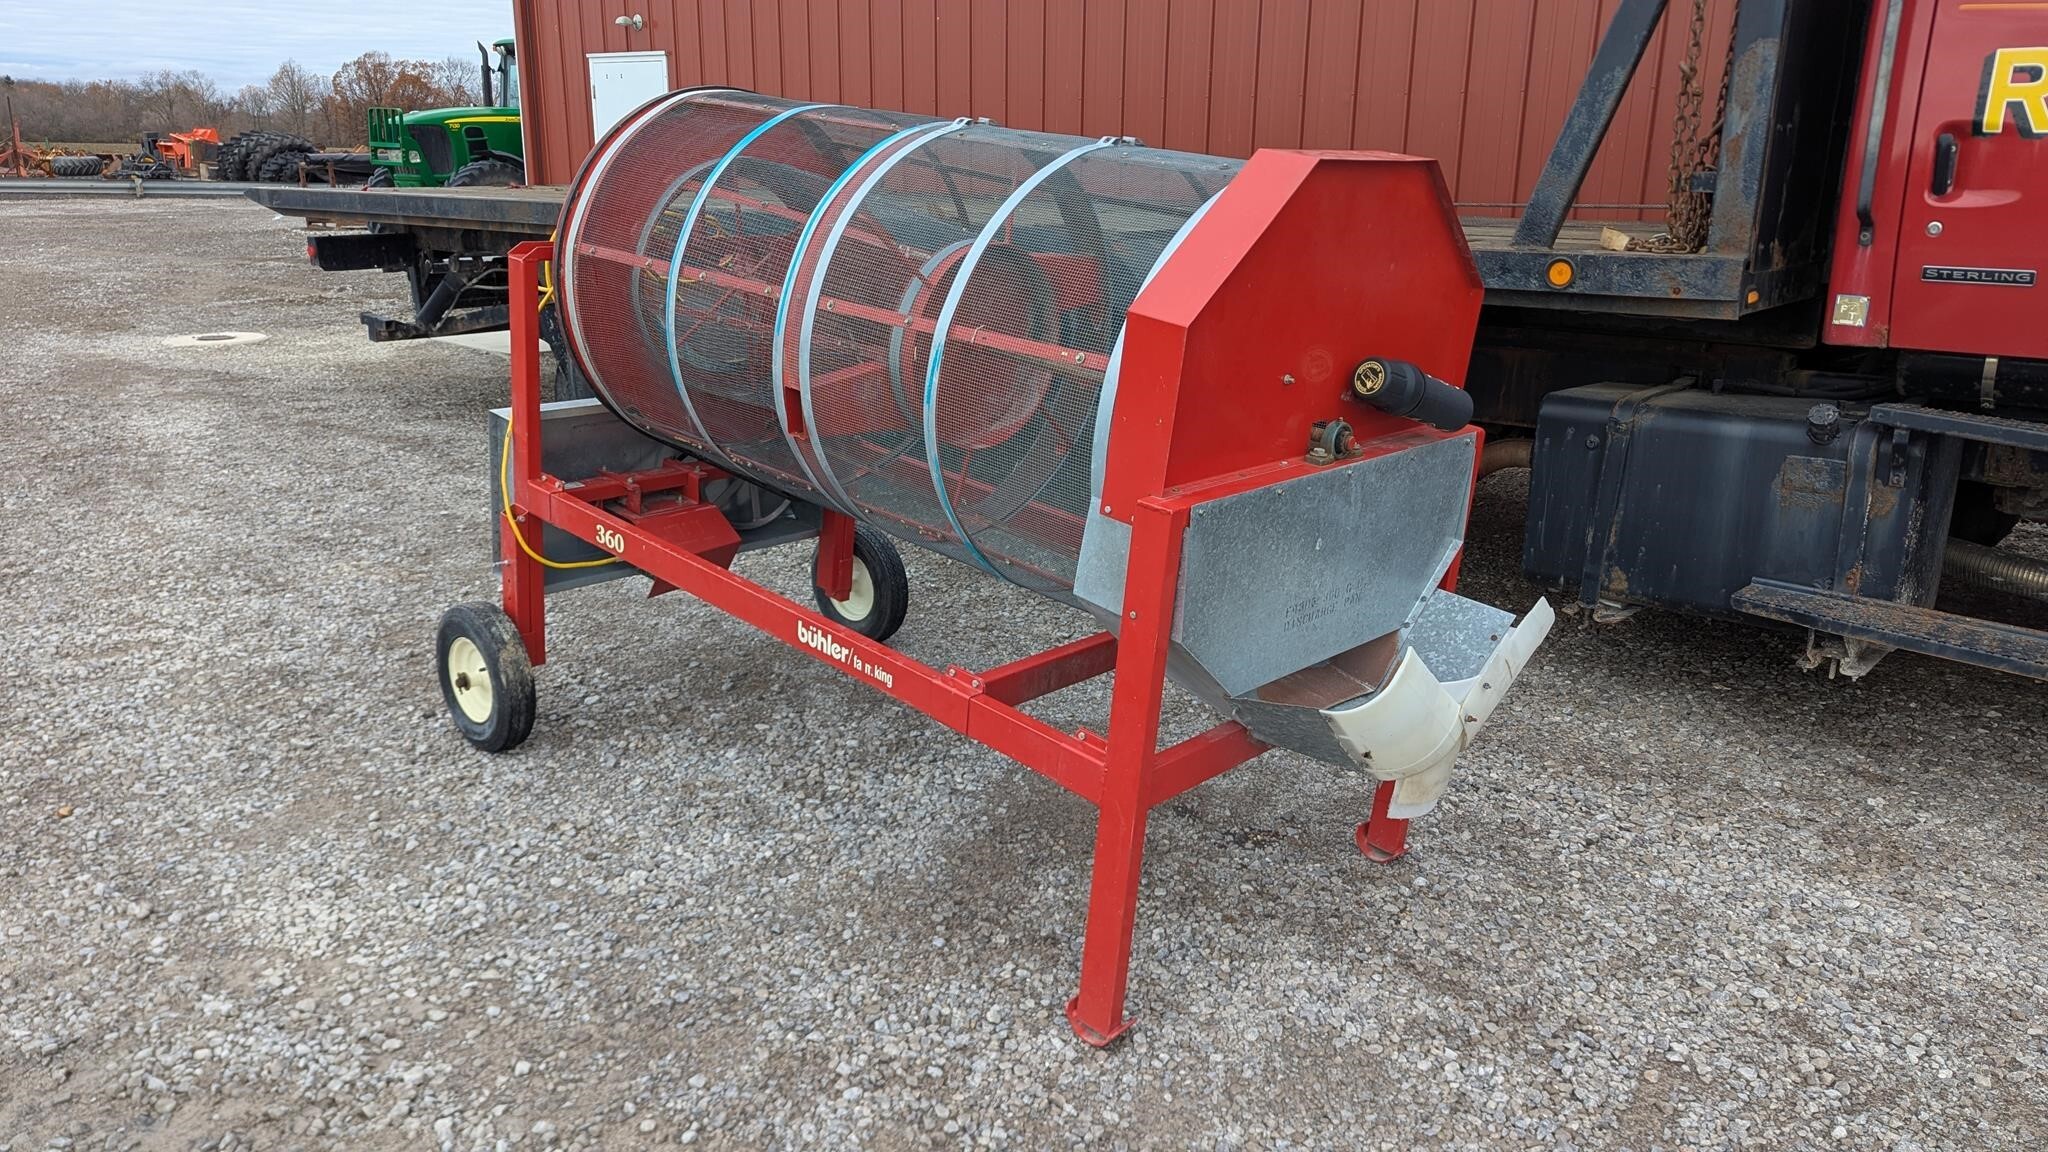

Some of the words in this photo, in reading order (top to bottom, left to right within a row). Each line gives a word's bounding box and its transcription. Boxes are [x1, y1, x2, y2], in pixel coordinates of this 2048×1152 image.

[1977, 47, 2048, 136] R
[1925, 268, 2031, 282] STERLING
[596, 524, 625, 553] 360
